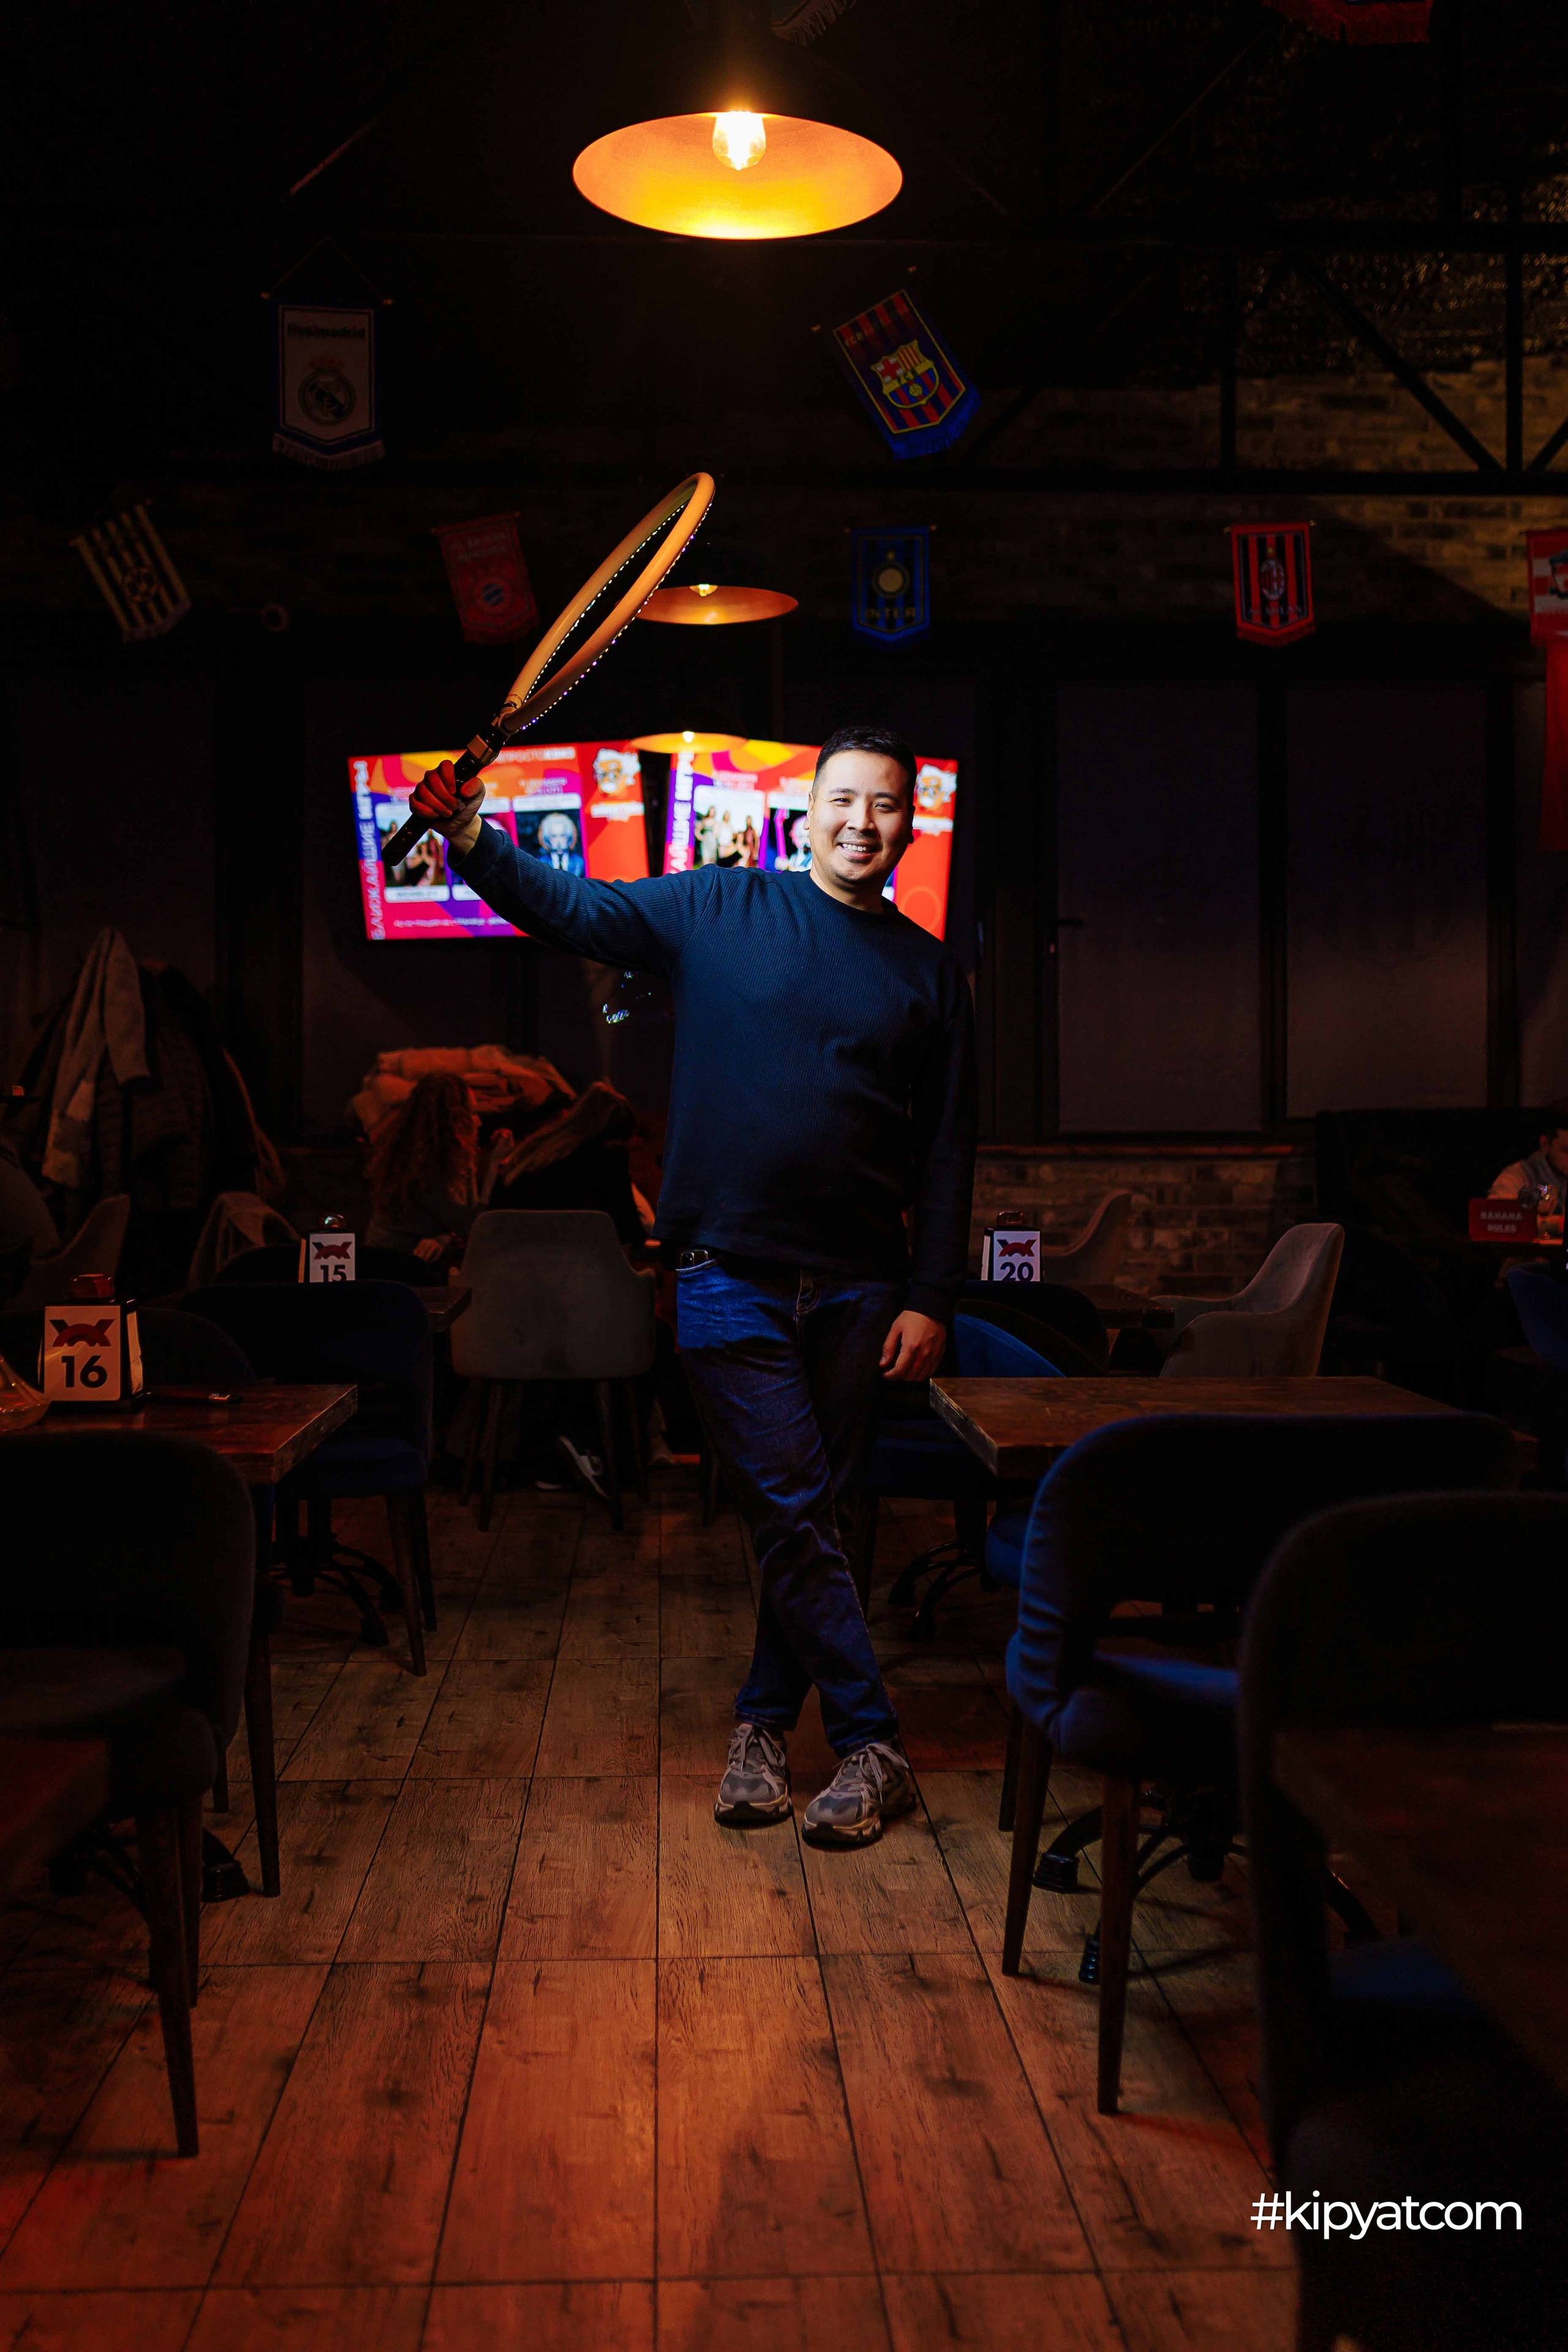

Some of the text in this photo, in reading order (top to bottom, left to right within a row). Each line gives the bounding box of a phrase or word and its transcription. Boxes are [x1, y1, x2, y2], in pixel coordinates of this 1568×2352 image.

[359, 821, 386, 940] БЛИЖАЙШИЕ
[320, 1265, 347, 1283] 15
[1000, 1262, 1034, 1281] 20
[62, 1355, 107, 1388] 16
